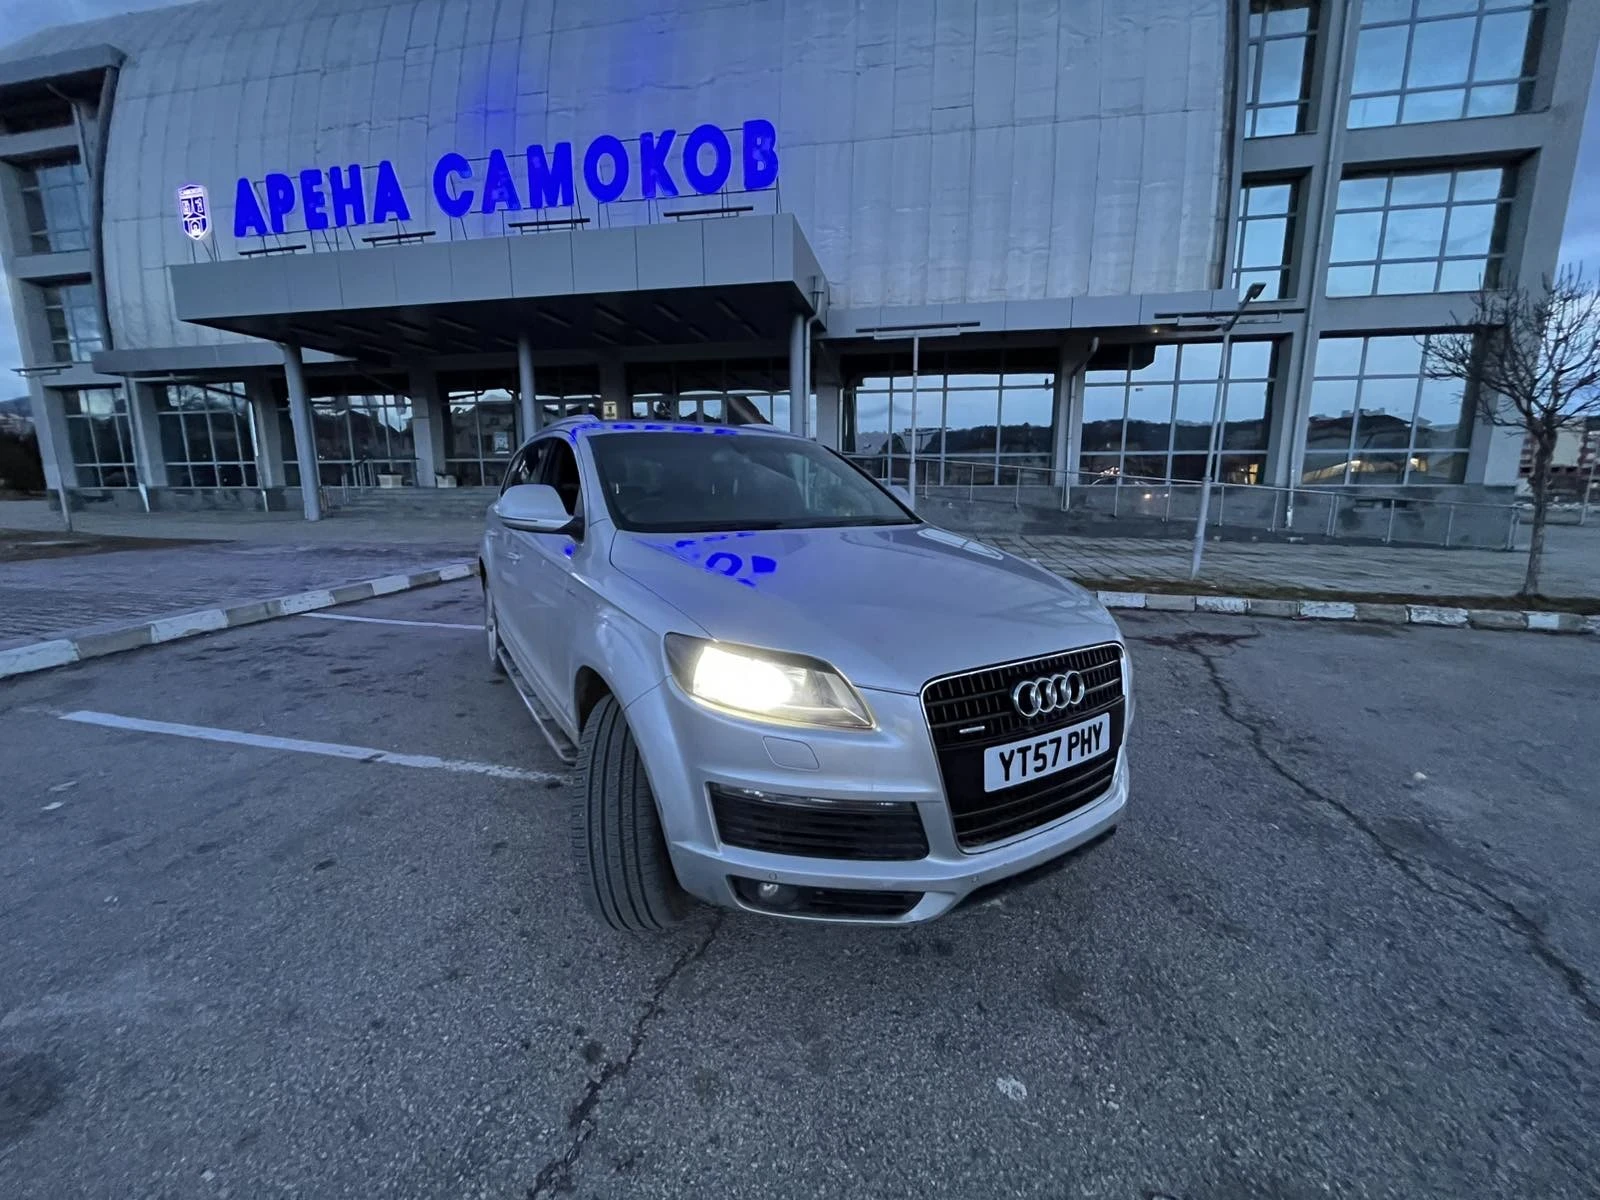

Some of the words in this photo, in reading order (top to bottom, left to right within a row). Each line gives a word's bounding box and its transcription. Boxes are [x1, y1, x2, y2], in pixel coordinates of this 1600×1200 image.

[233, 160, 411, 238] АРЕНА
[432, 118, 779, 218] САМОКОВ
[998, 736, 1062, 782] YT57
[1066, 721, 1104, 762] PHY
